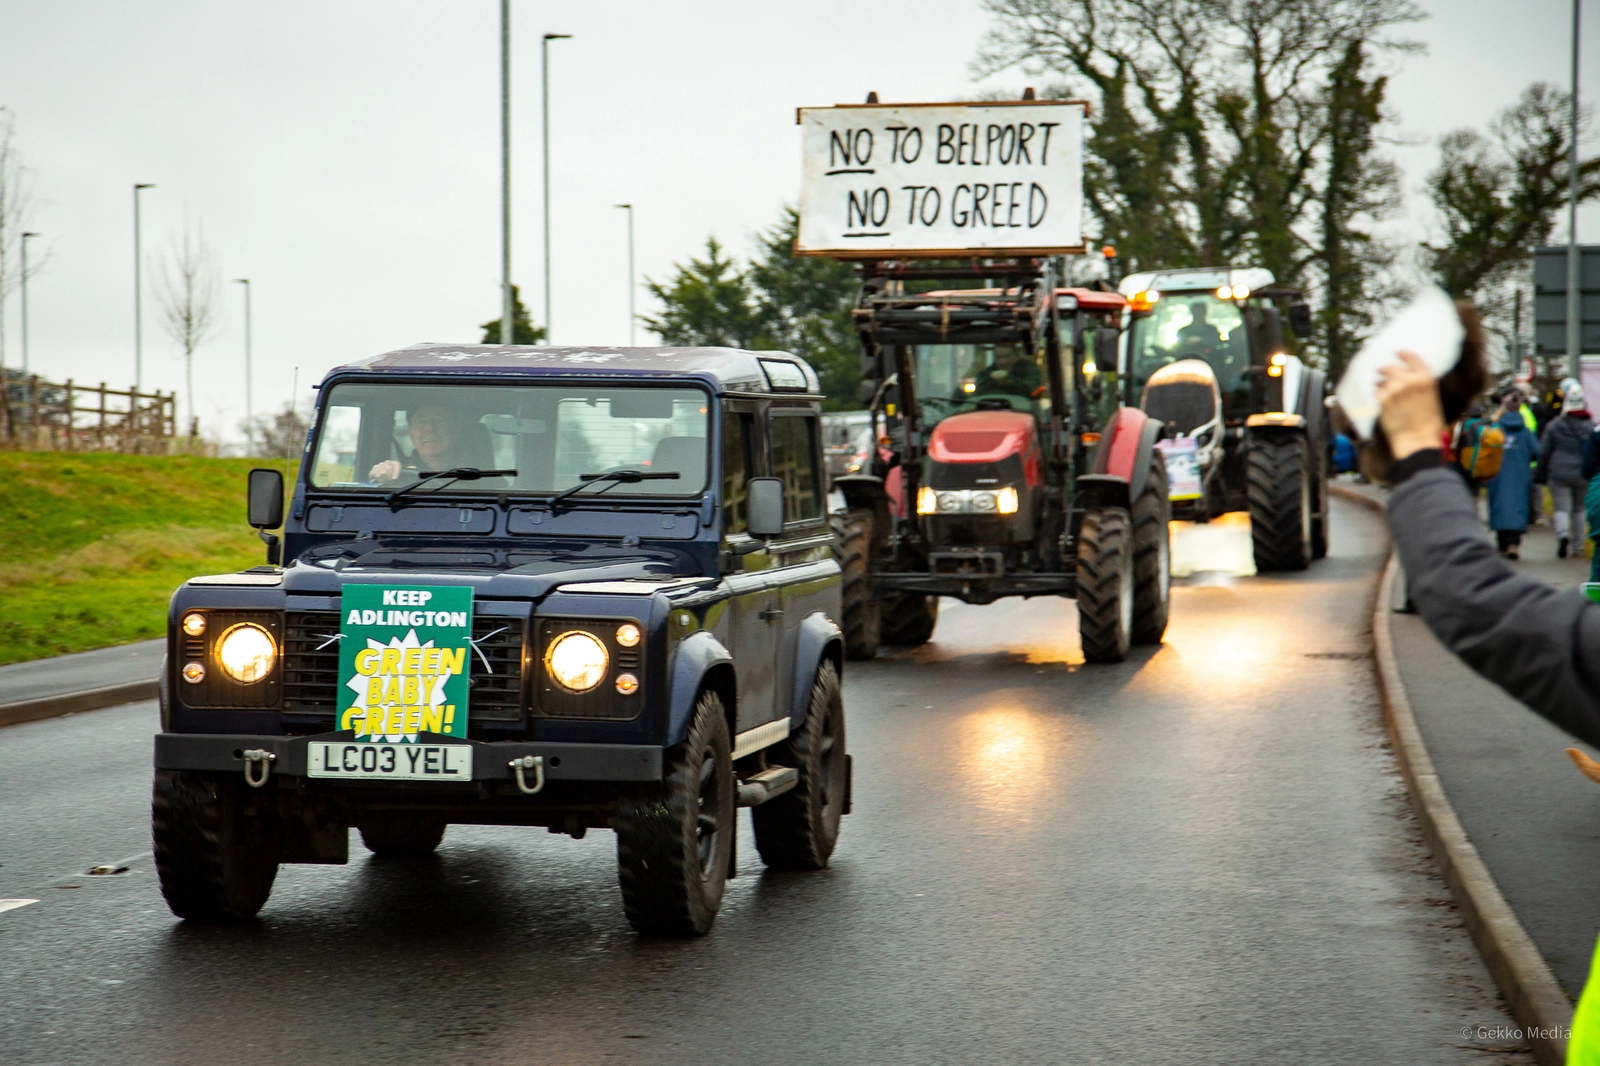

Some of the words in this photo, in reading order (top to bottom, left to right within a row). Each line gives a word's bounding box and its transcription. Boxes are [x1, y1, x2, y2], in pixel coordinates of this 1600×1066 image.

[830, 128, 874, 167] NO
[884, 126, 923, 164] TO
[936, 122, 1061, 166] BELPORT
[847, 186, 891, 228] NO
[901, 185, 942, 226] TO
[952, 182, 1048, 229] GREED
[382, 590, 433, 607] KEEP
[346, 609, 468, 628] ADLINGTON
[353, 647, 467, 677] GREEN
[365, 675, 440, 707] BABY
[340, 704, 456, 735] GREEN!
[323, 745, 396, 773] LC03
[405, 747, 459, 775] YEL
